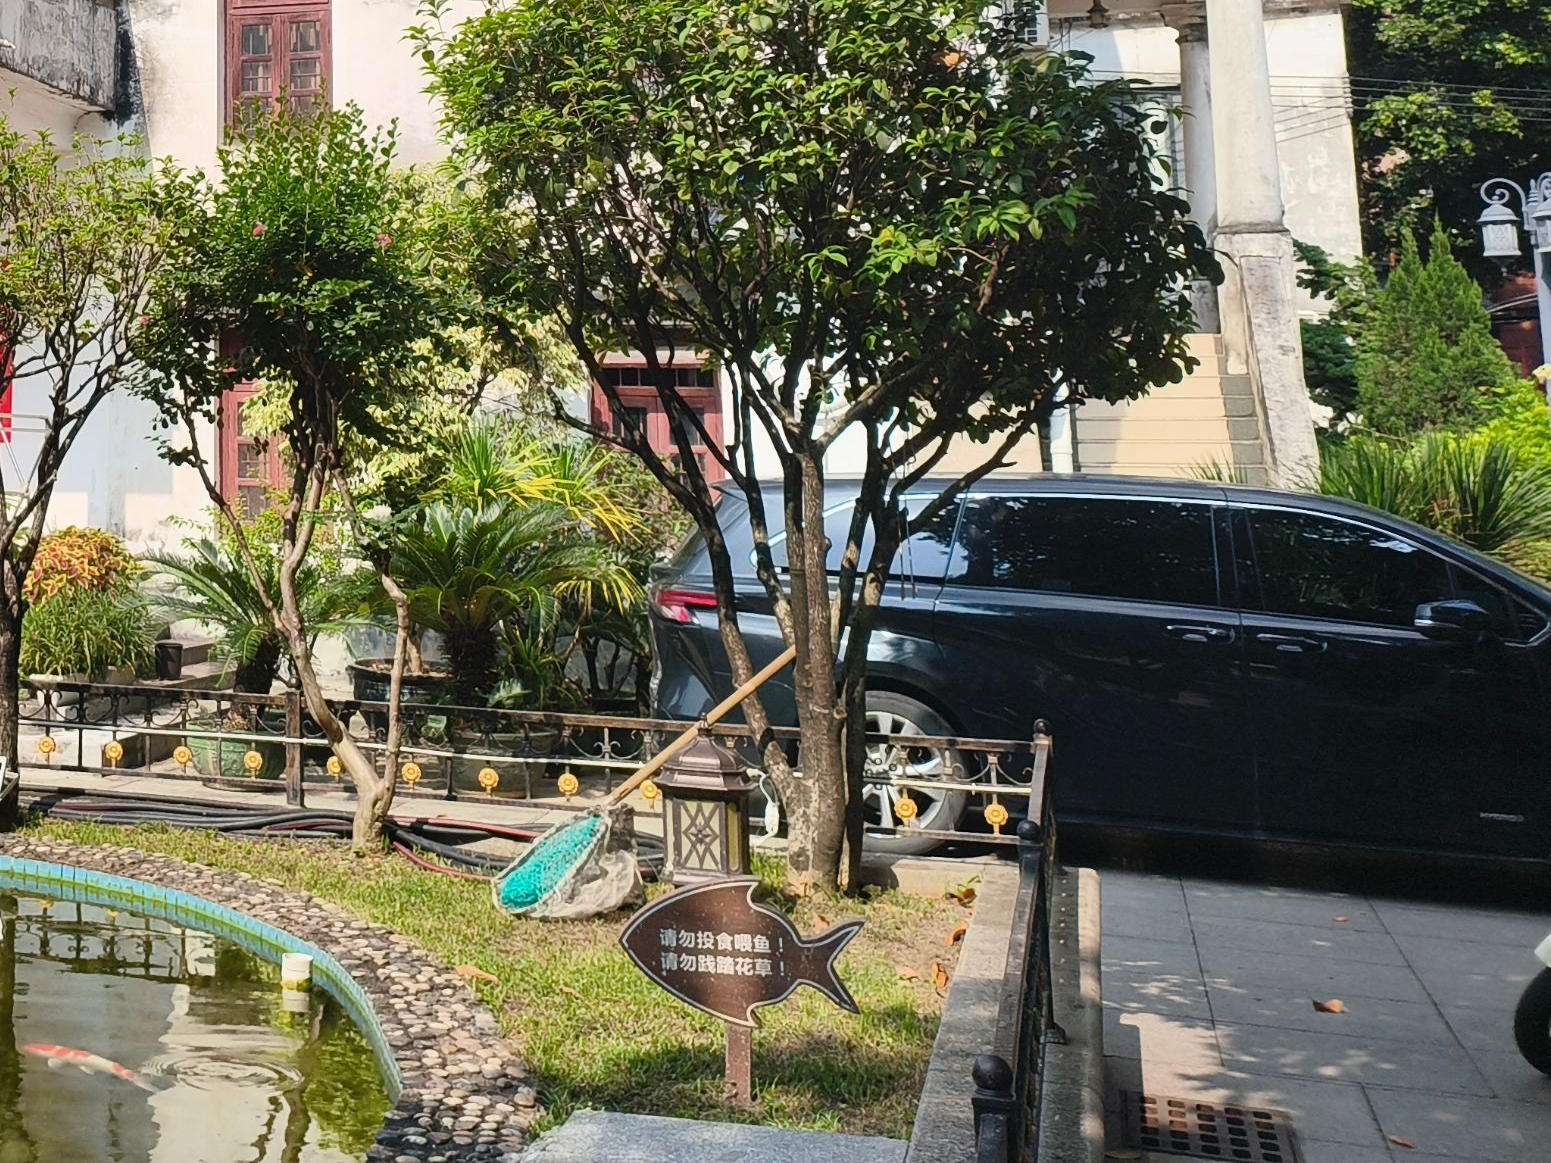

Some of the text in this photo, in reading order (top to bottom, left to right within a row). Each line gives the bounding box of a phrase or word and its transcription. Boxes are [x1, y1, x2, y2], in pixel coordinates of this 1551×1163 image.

[659, 928, 784, 954] 请勿投食喂鱼！
[660, 951, 786, 977] 请勿践踏花草！
